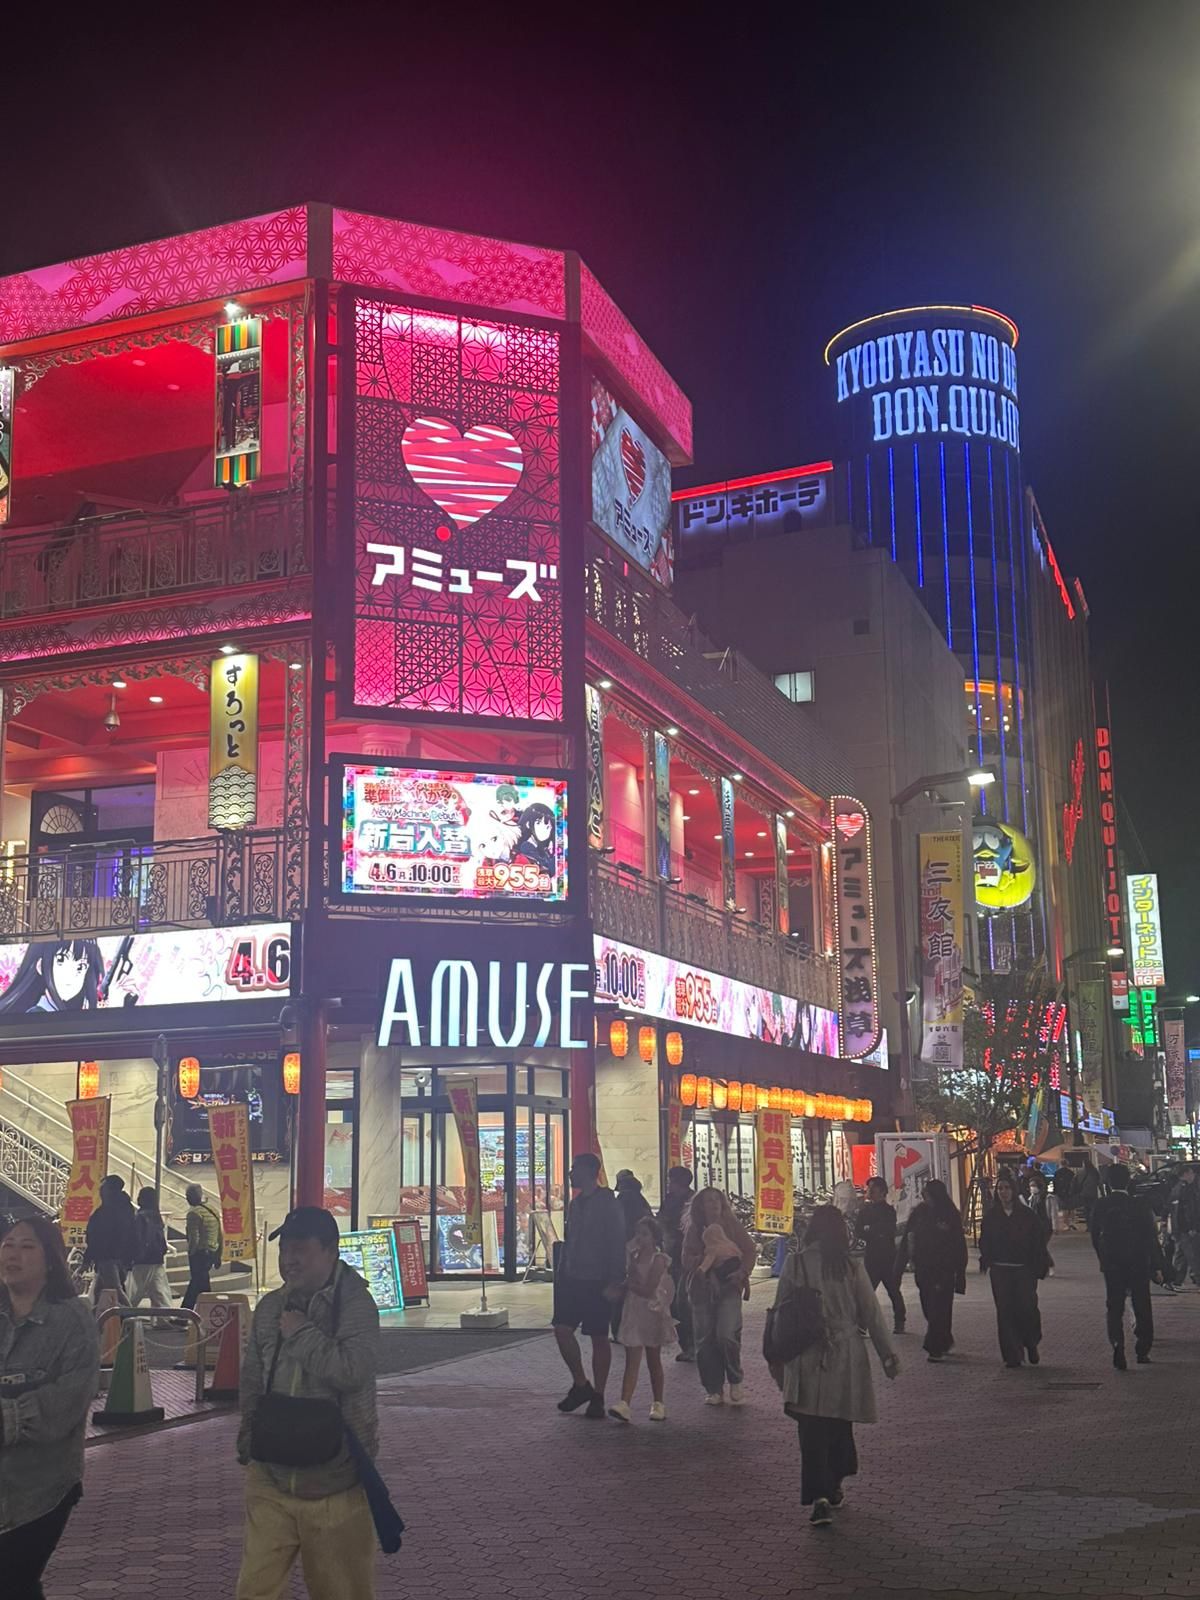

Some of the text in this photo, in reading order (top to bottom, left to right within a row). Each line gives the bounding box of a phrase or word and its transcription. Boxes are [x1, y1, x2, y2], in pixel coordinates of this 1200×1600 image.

[836, 328, 965, 403] KYOUYASU
[970, 331, 1000, 384] NO
[872, 384, 1020, 453] DON.QUIJO
[366, 542, 558, 602] アミューズ
[225, 664, 246, 758] すろっと
[927, 861, 955, 959] 三友館
[1131, 875, 1158, 959] インターネット
[229, 936, 291, 989] 4.6
[377, 958, 590, 1048] AMUSE
[65, 1104, 98, 1222] 新台入替
[761, 1112, 785, 1211] 新台入替
